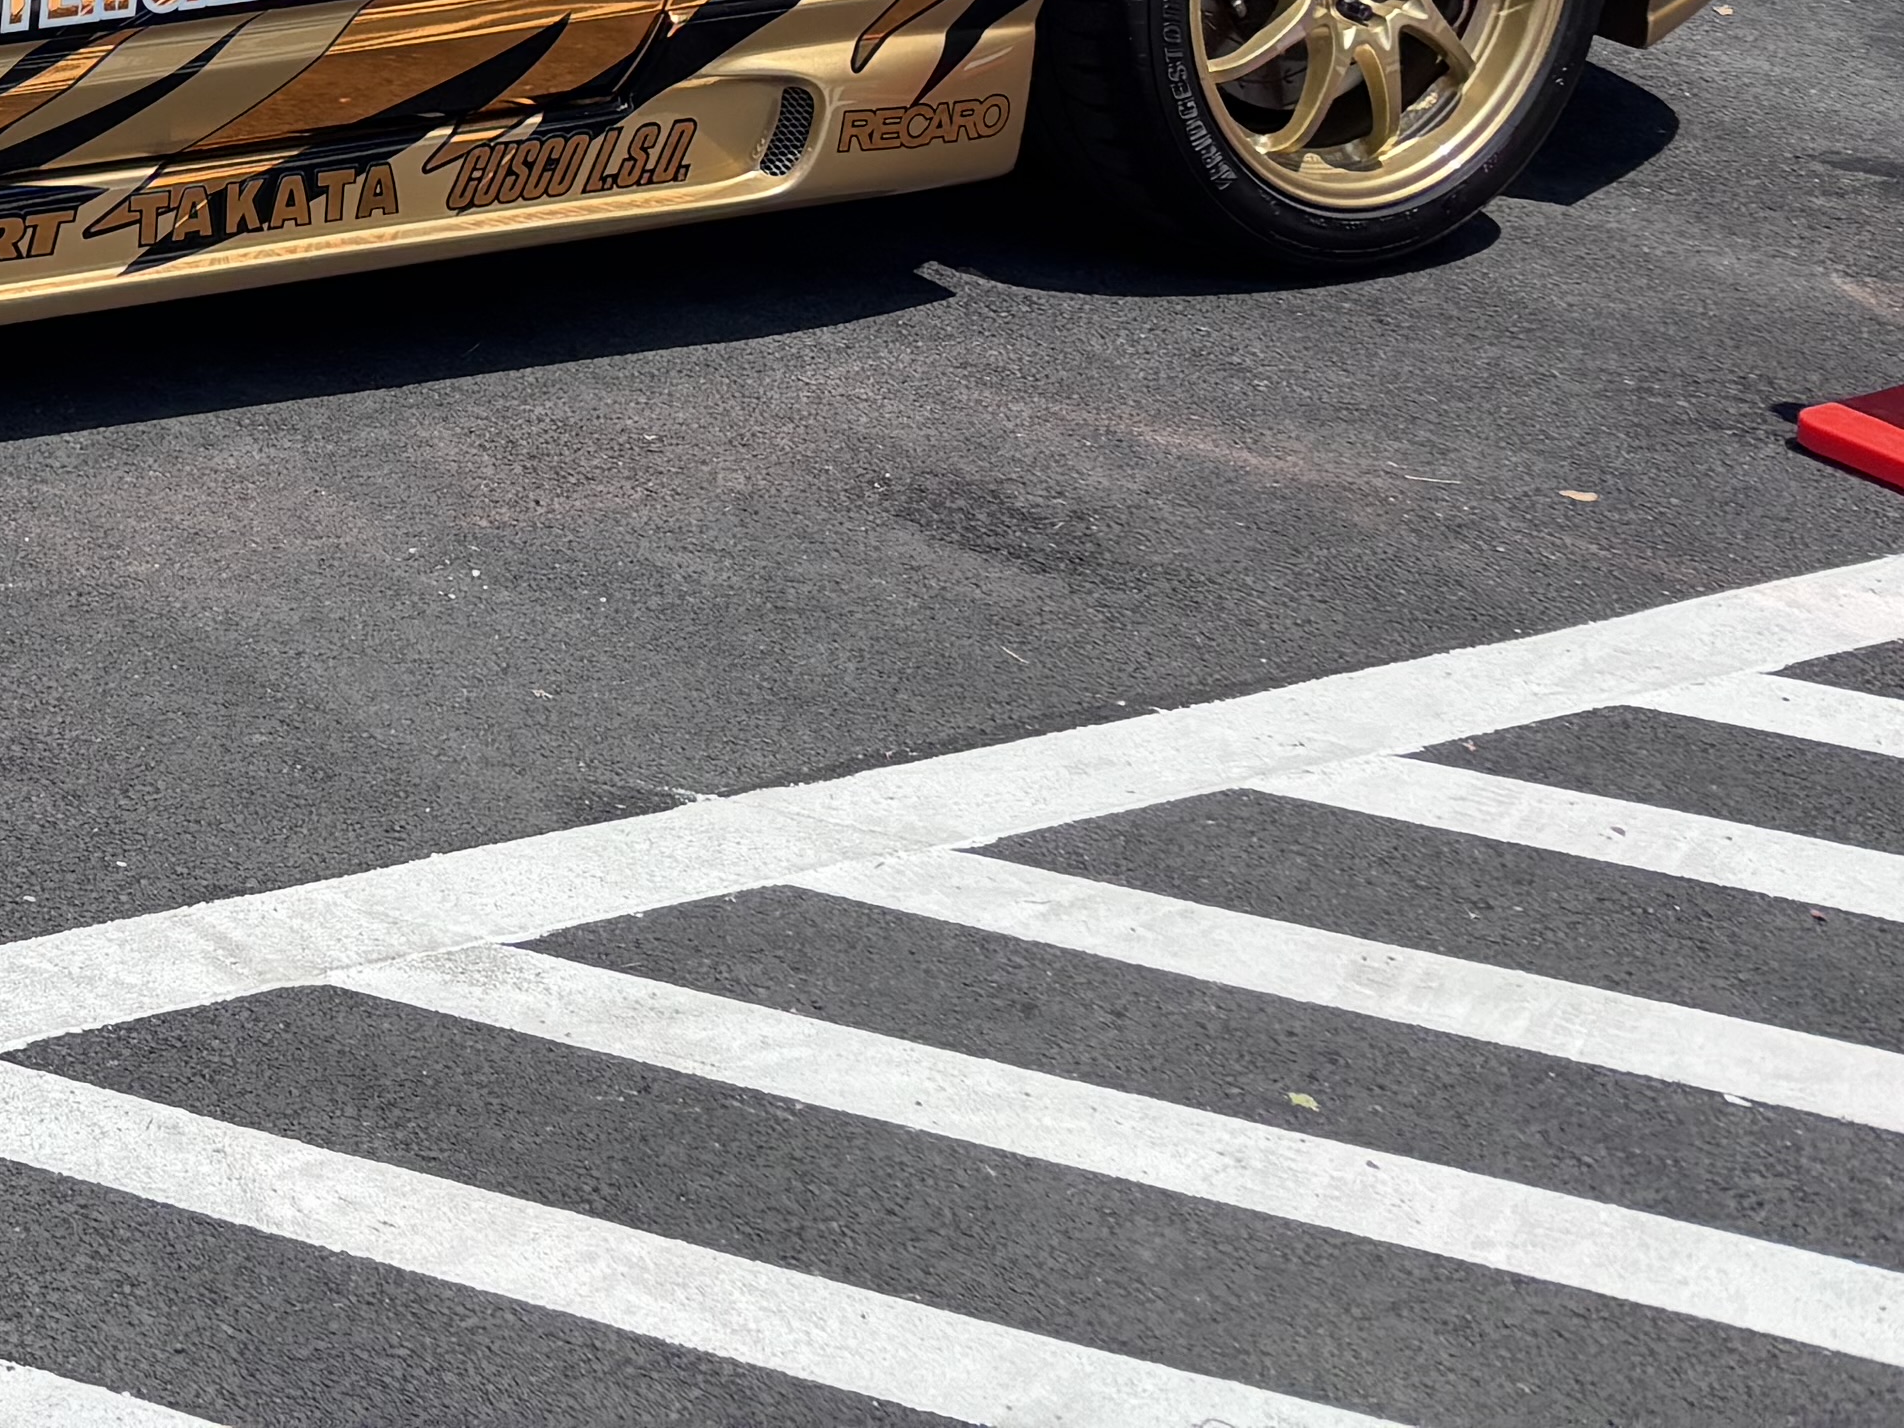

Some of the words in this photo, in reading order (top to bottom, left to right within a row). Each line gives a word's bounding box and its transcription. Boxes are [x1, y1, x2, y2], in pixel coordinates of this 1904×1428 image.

[446, 130, 595, 212] CUSCO
[581, 117, 699, 194] L.S.D.
[836, 94, 1010, 153] RECARO
[122, 158, 402, 252] TAKATA
